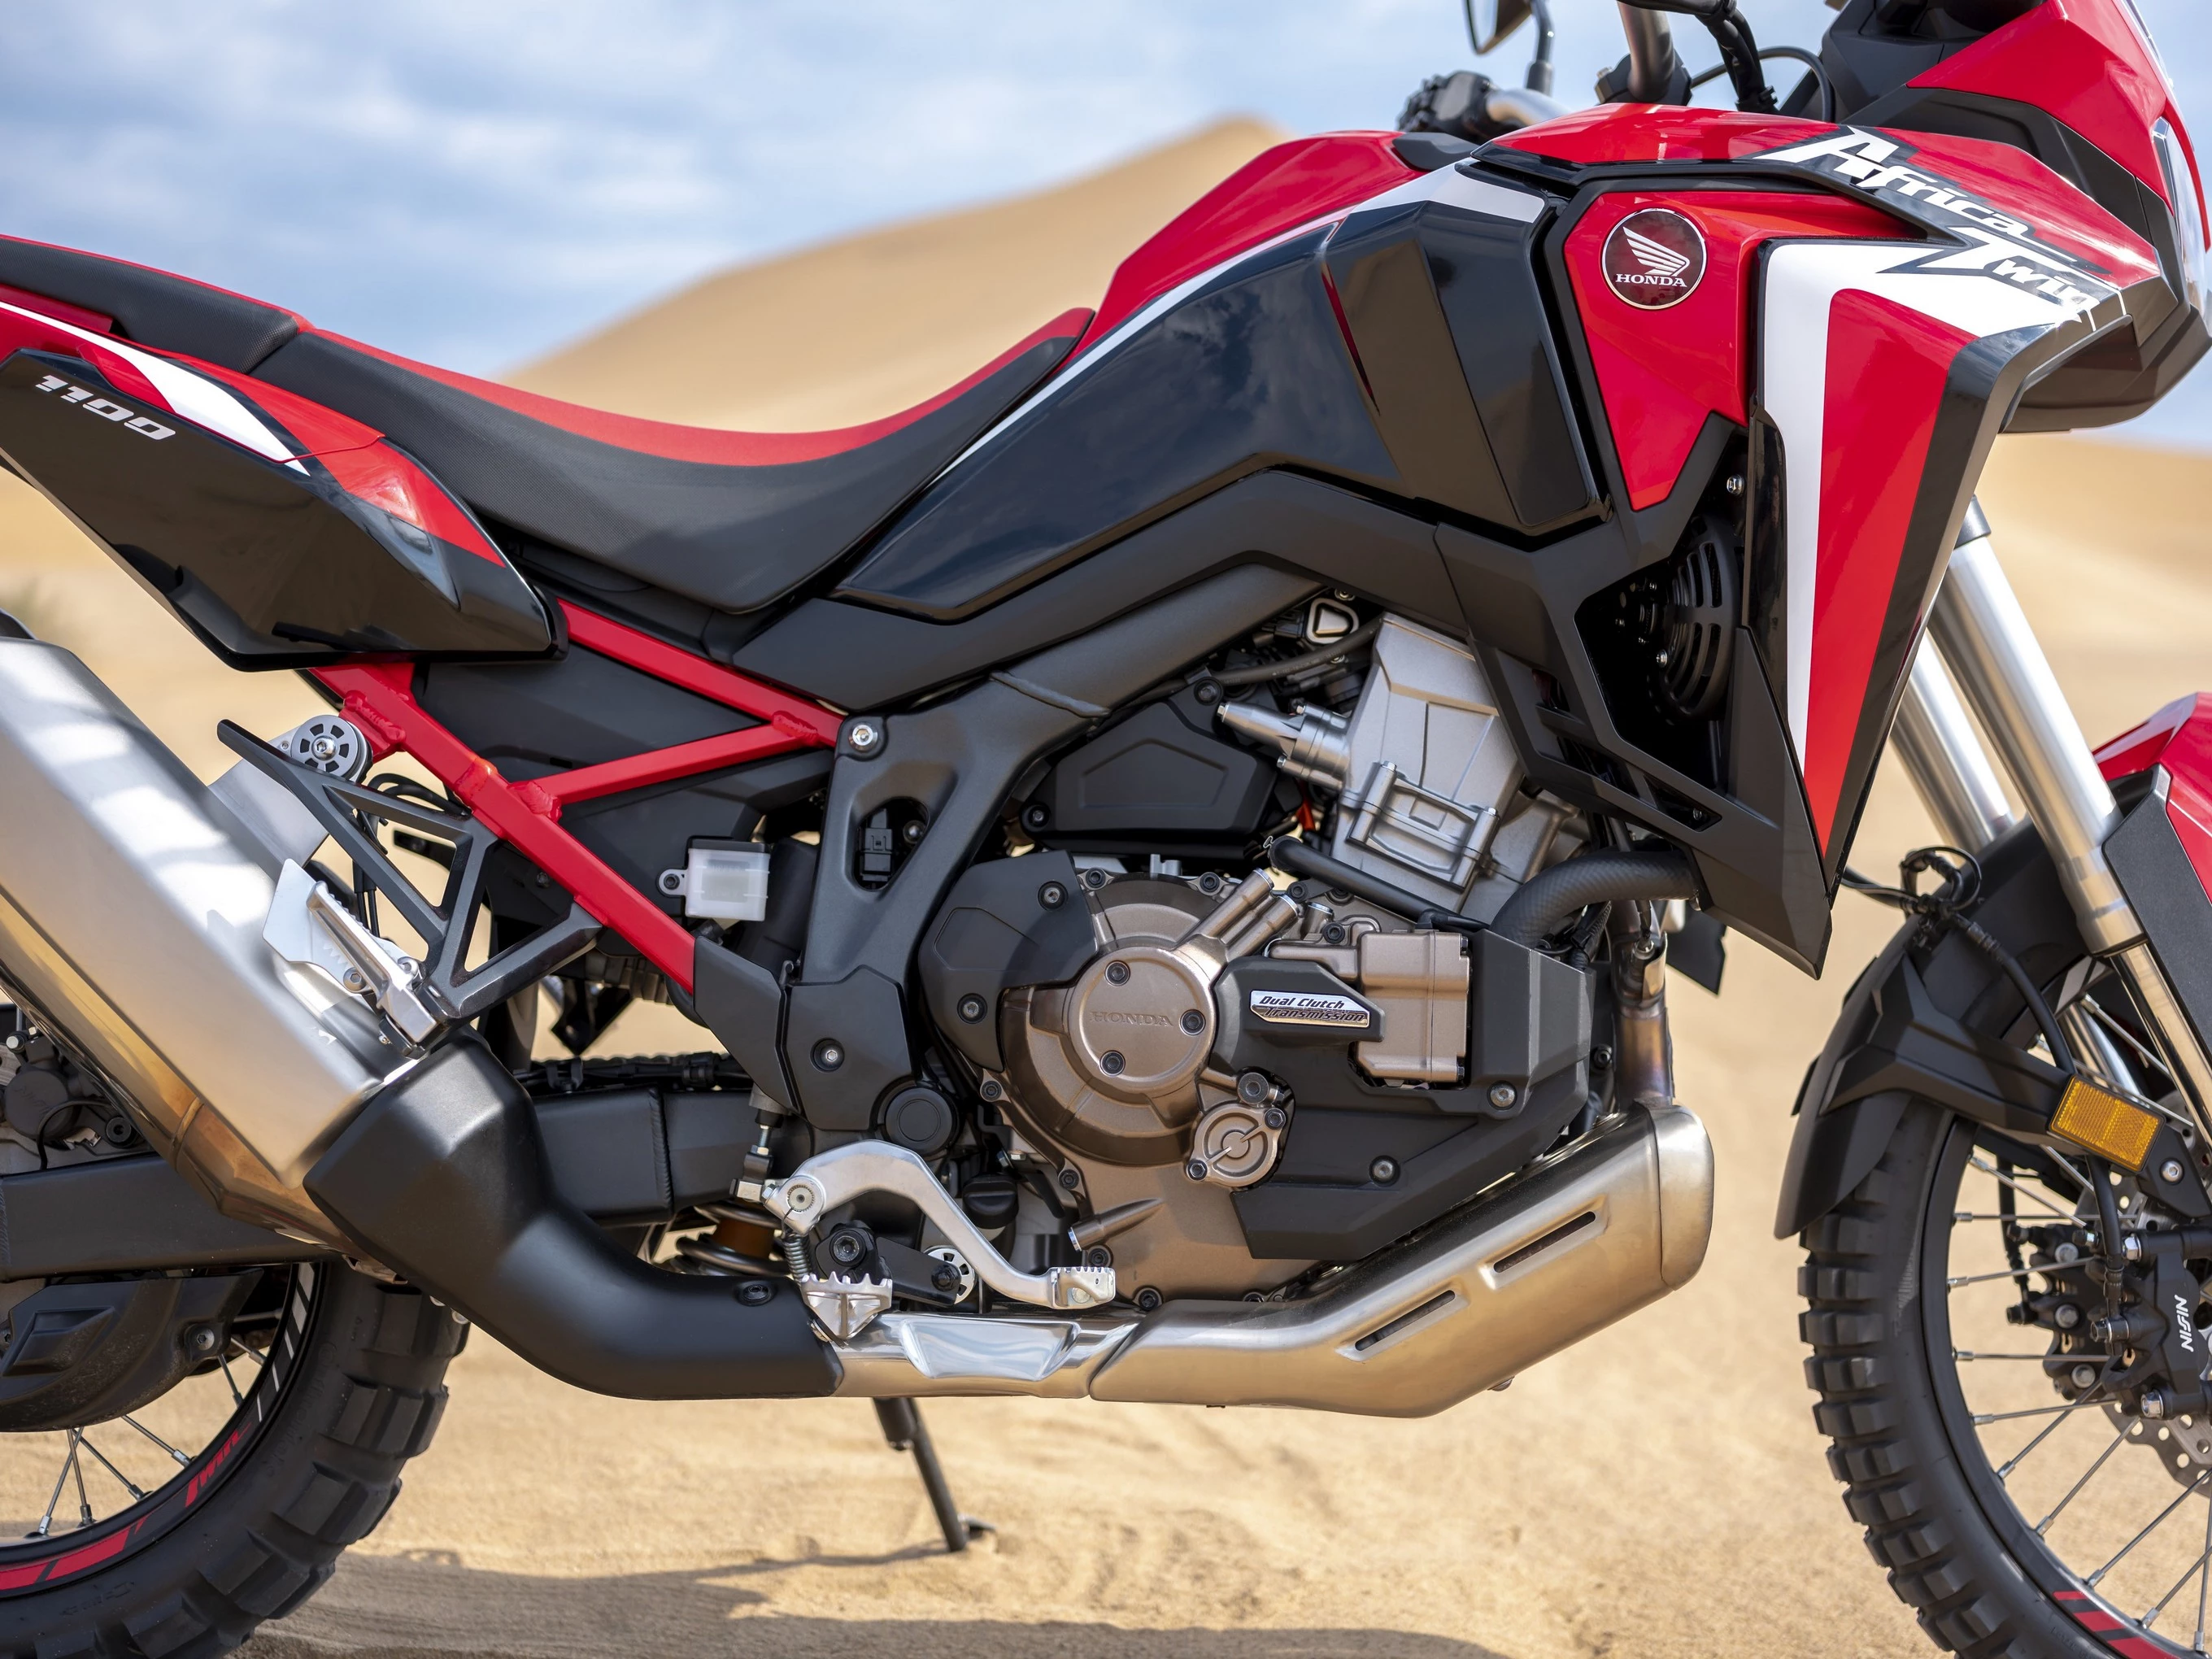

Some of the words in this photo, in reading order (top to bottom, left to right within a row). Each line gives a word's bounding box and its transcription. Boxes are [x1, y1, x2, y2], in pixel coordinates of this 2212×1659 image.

[1752, 125, 2077, 262] Africa
[1615, 273, 1687, 288] HONDA
[1917, 226, 2119, 323] Twin
[35, 375, 176, 440] 1100
[1259, 995, 1296, 1006] Dual
[1297, 998, 1345, 1009] Clutch
[1090, 1011, 1174, 1026] HONDA
[1265, 1008, 1365, 1022] Transmission
